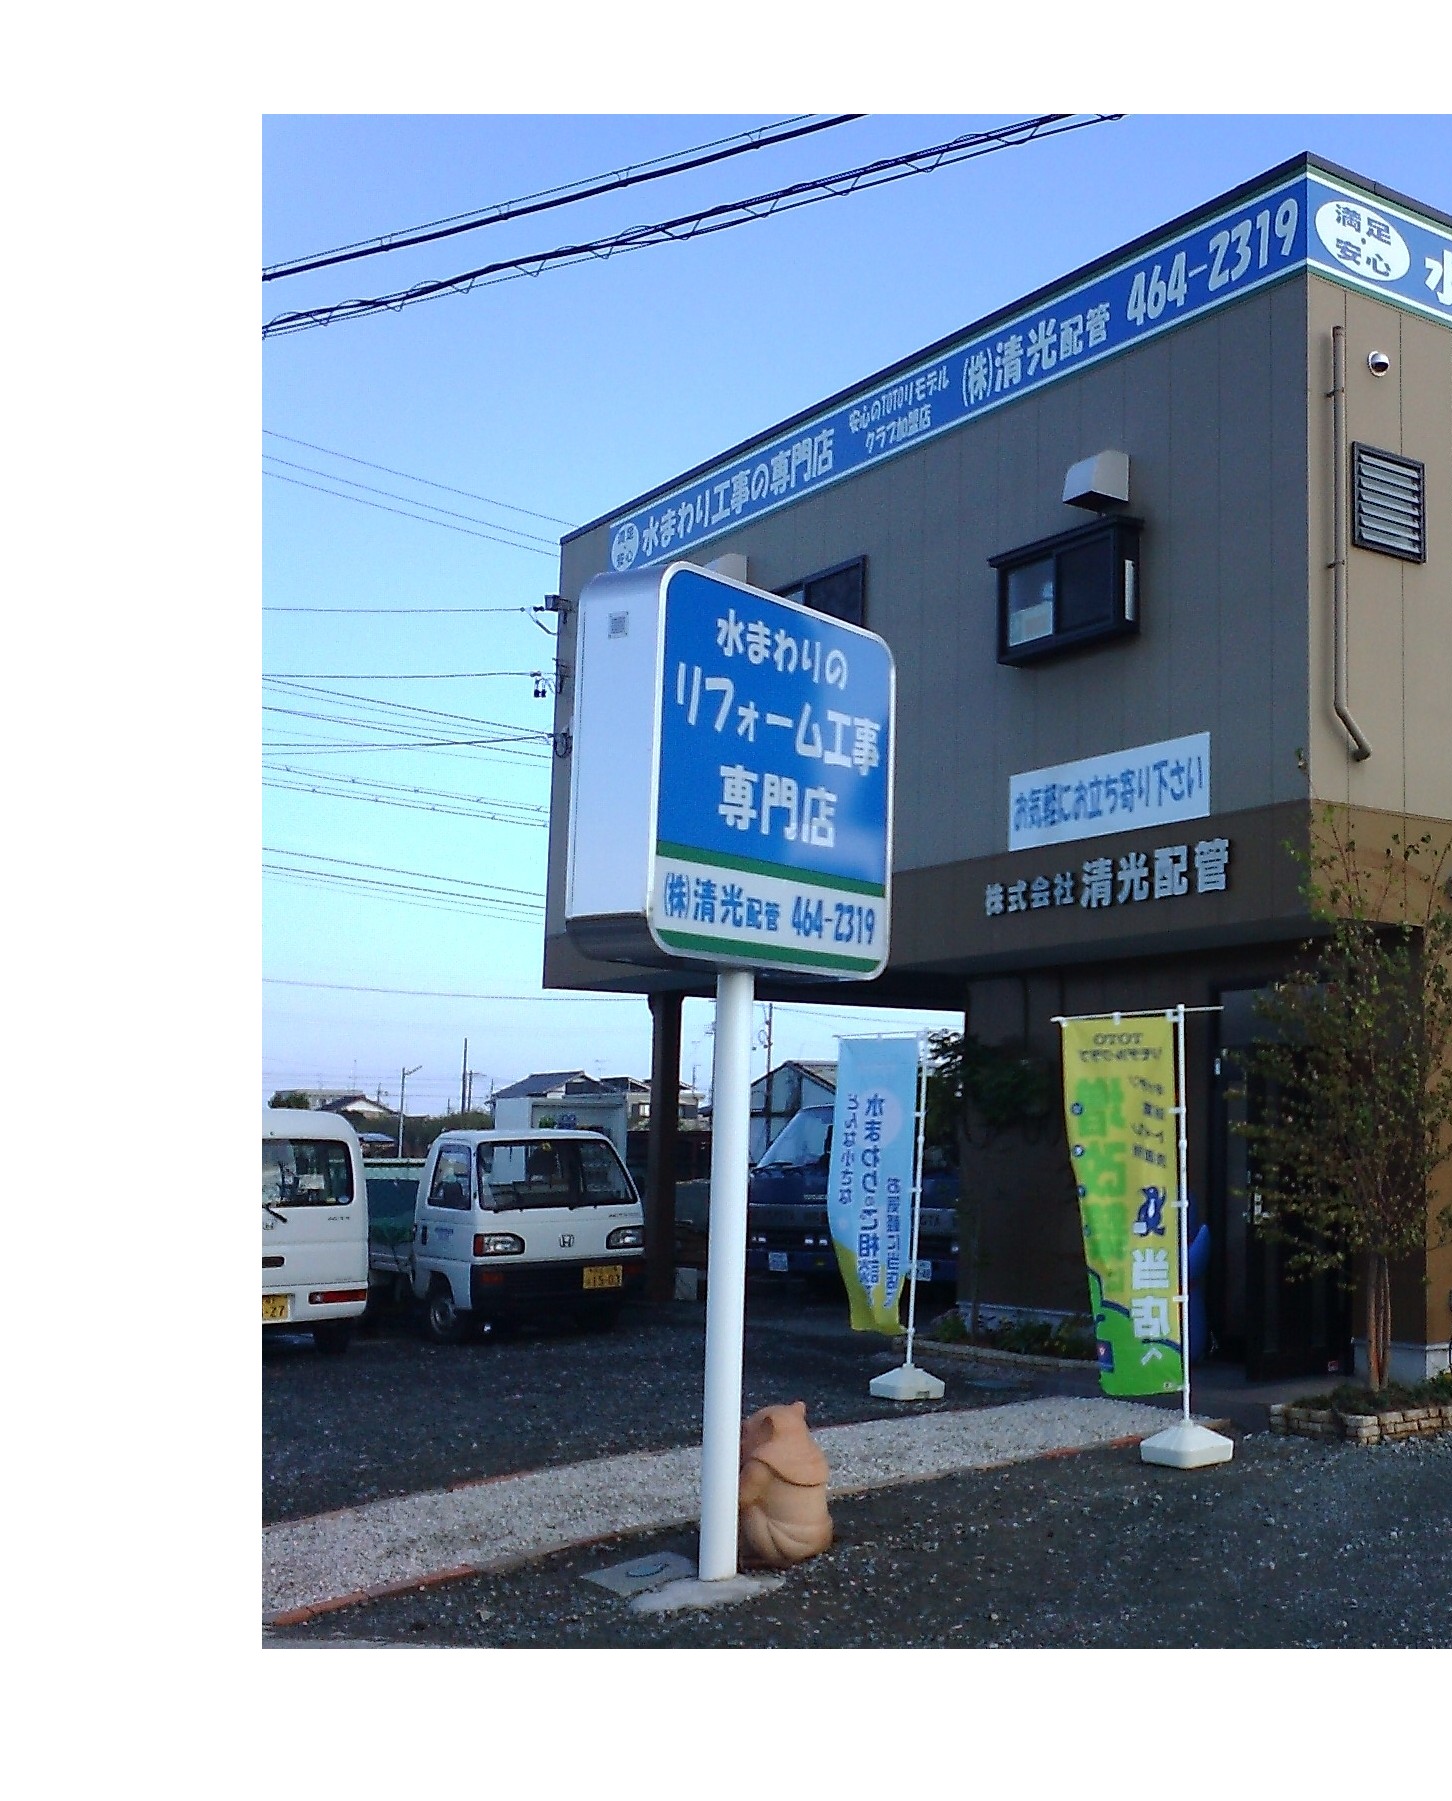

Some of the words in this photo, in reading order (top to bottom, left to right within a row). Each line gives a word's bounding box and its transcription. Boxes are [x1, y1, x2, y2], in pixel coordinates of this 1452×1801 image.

[1126, 198, 1299, 327] 464-2319
[1335, 203, 1391, 246] 満足
[1335, 237, 1391, 277] 安心
[642, 428, 835, 557] 水まわり工事の専門店
[716, 608, 849, 690] 水まわりの
[676, 661, 881, 776] リフォーム工事
[718, 764, 838, 848] 専門店
[1013, 756, 1203, 832] お気軽にお立ち寄り下さい
[791, 895, 876, 946] 464-2319
